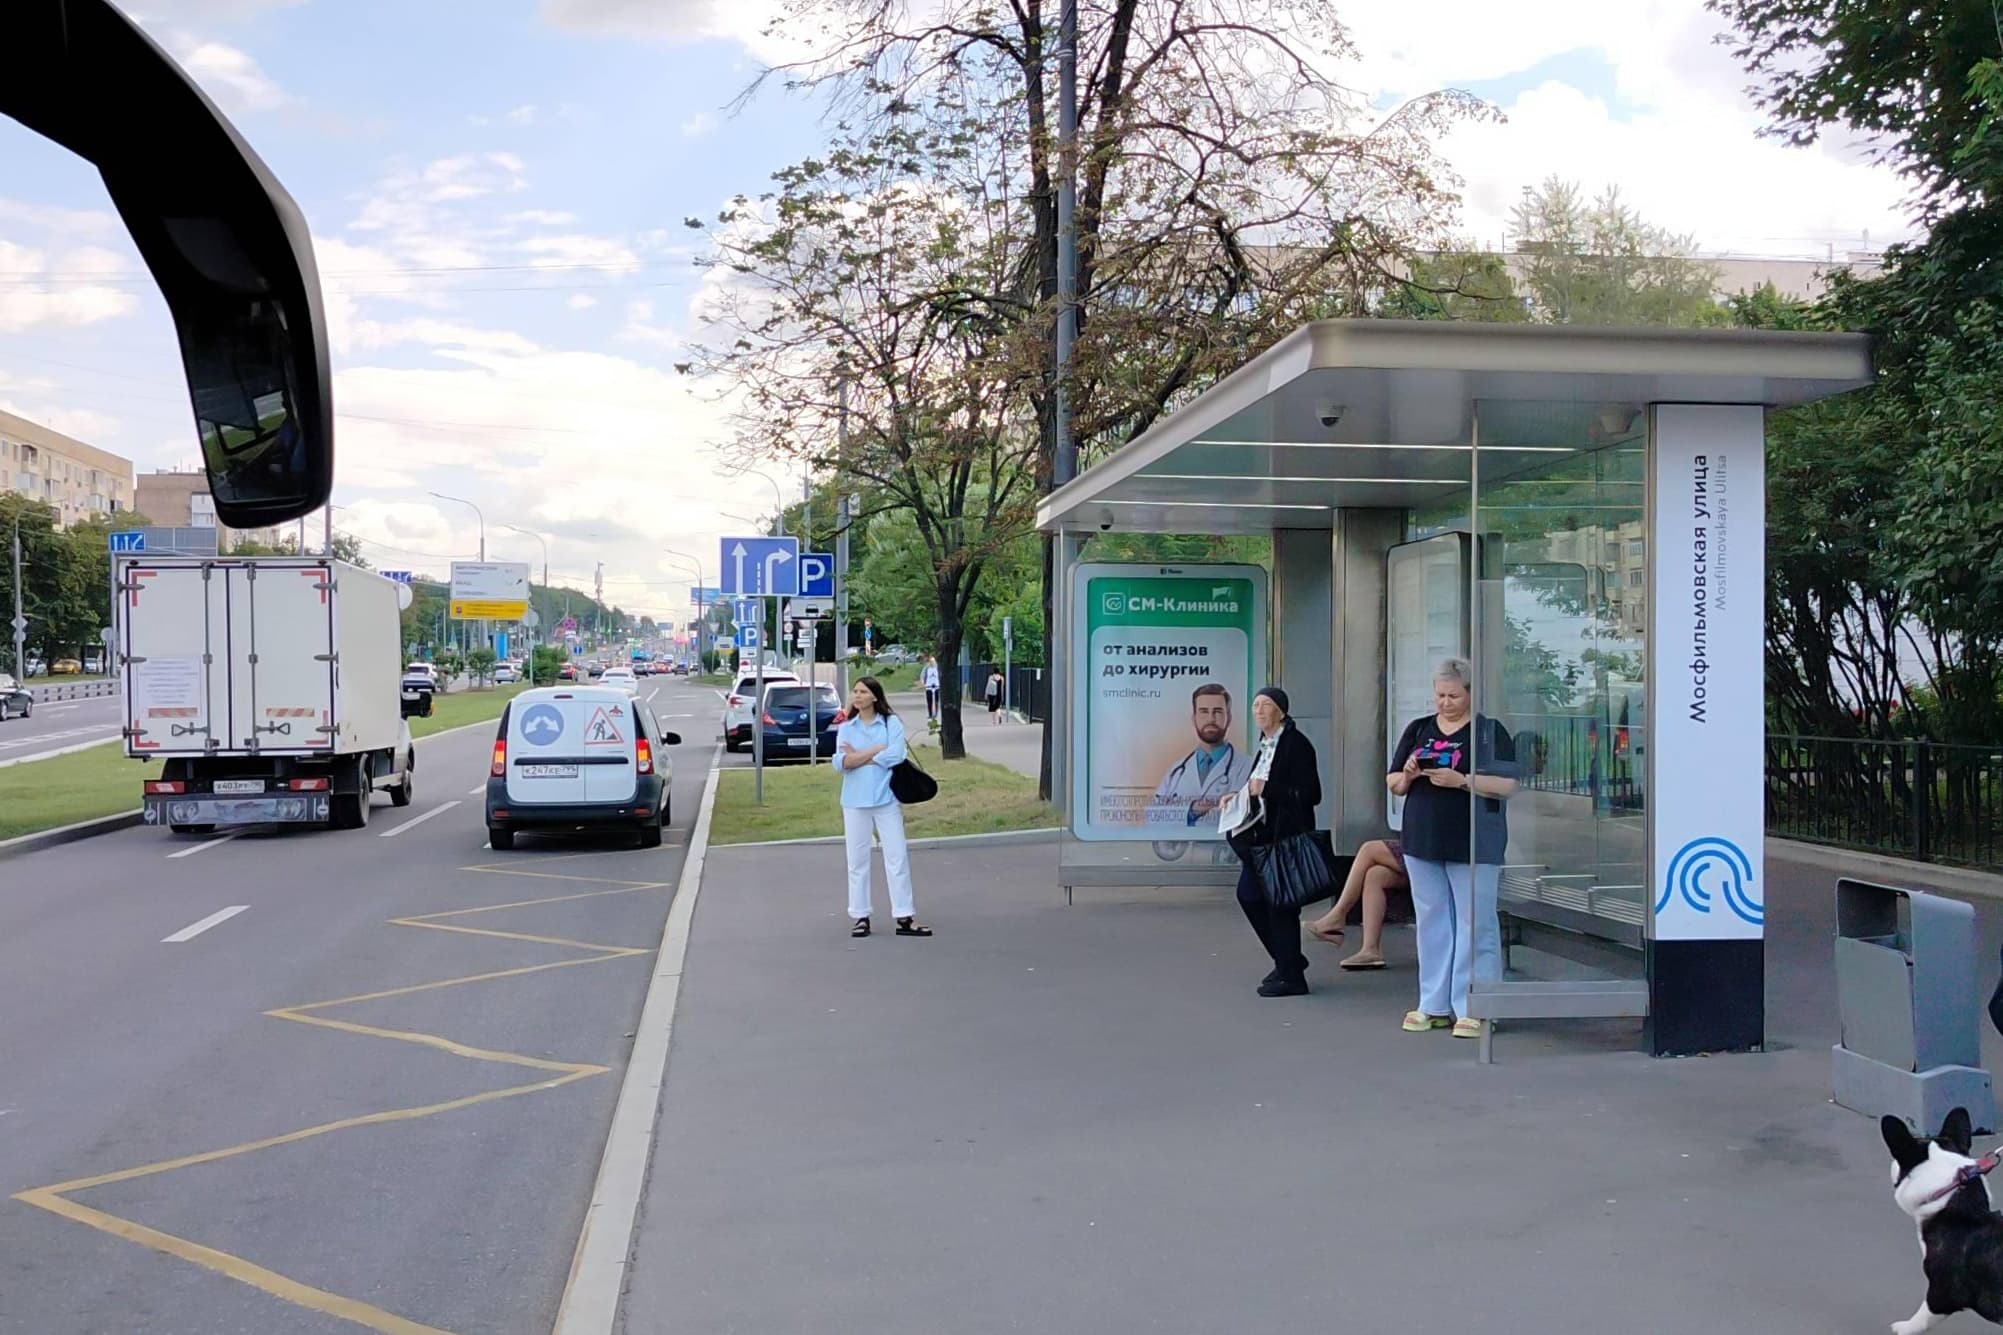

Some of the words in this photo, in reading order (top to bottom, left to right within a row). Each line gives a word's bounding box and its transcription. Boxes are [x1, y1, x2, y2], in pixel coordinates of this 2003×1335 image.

[1693, 454, 1711, 520] улица
[1715, 454, 1727, 494] Ulitsa
[1715, 498, 1729, 610] Mosfilmovskaya
[801, 558, 826, 592] P
[1128, 597, 1239, 613] СМ-Клиника
[1689, 526, 1710, 723] Мосфильмовская
[1103, 645, 1123, 656] от
[1126, 645, 1208, 657] анализов
[1102, 664, 1125, 677] до
[1128, 664, 1210, 680] хирургии
[1102, 687, 1161, 699] smclinic.ru
